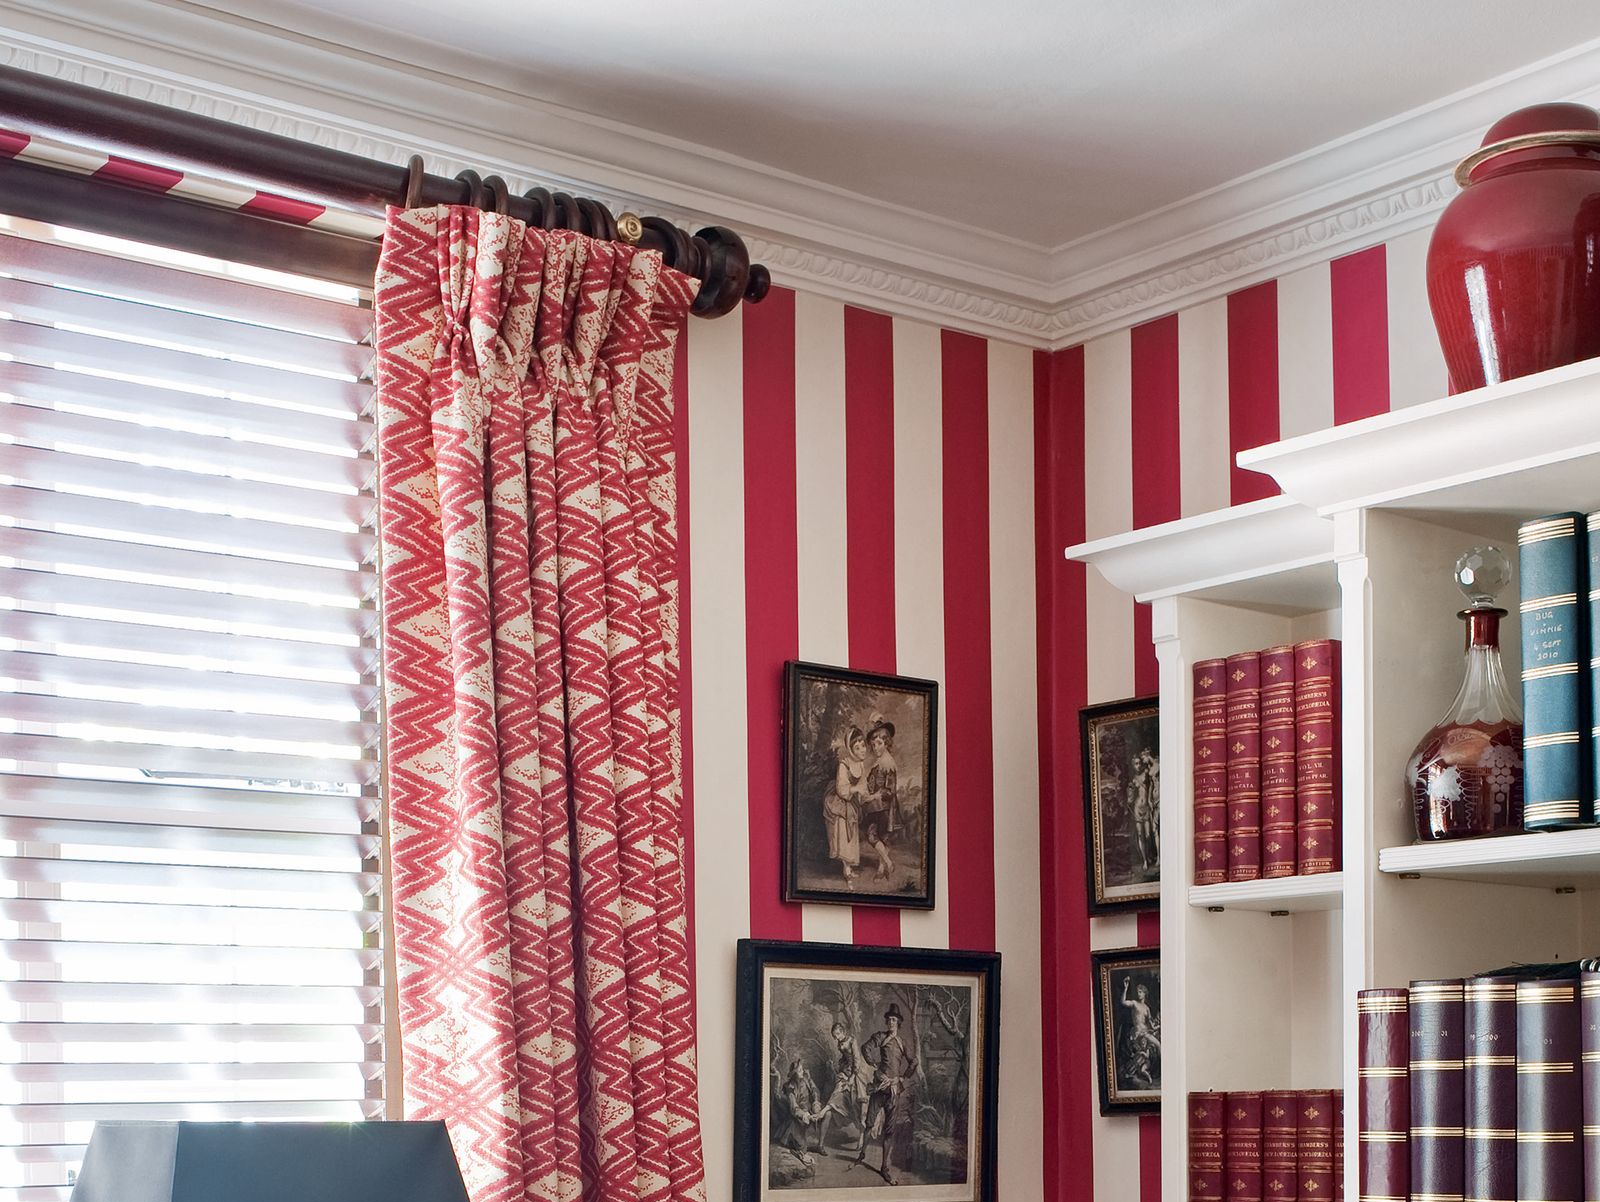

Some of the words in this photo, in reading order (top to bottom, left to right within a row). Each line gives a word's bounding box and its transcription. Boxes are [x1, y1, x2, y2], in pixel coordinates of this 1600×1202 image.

[1535, 611, 1554, 621] BUG
[1542, 639, 1562, 649] SEPT
[1536, 651, 1559, 661] 2010
